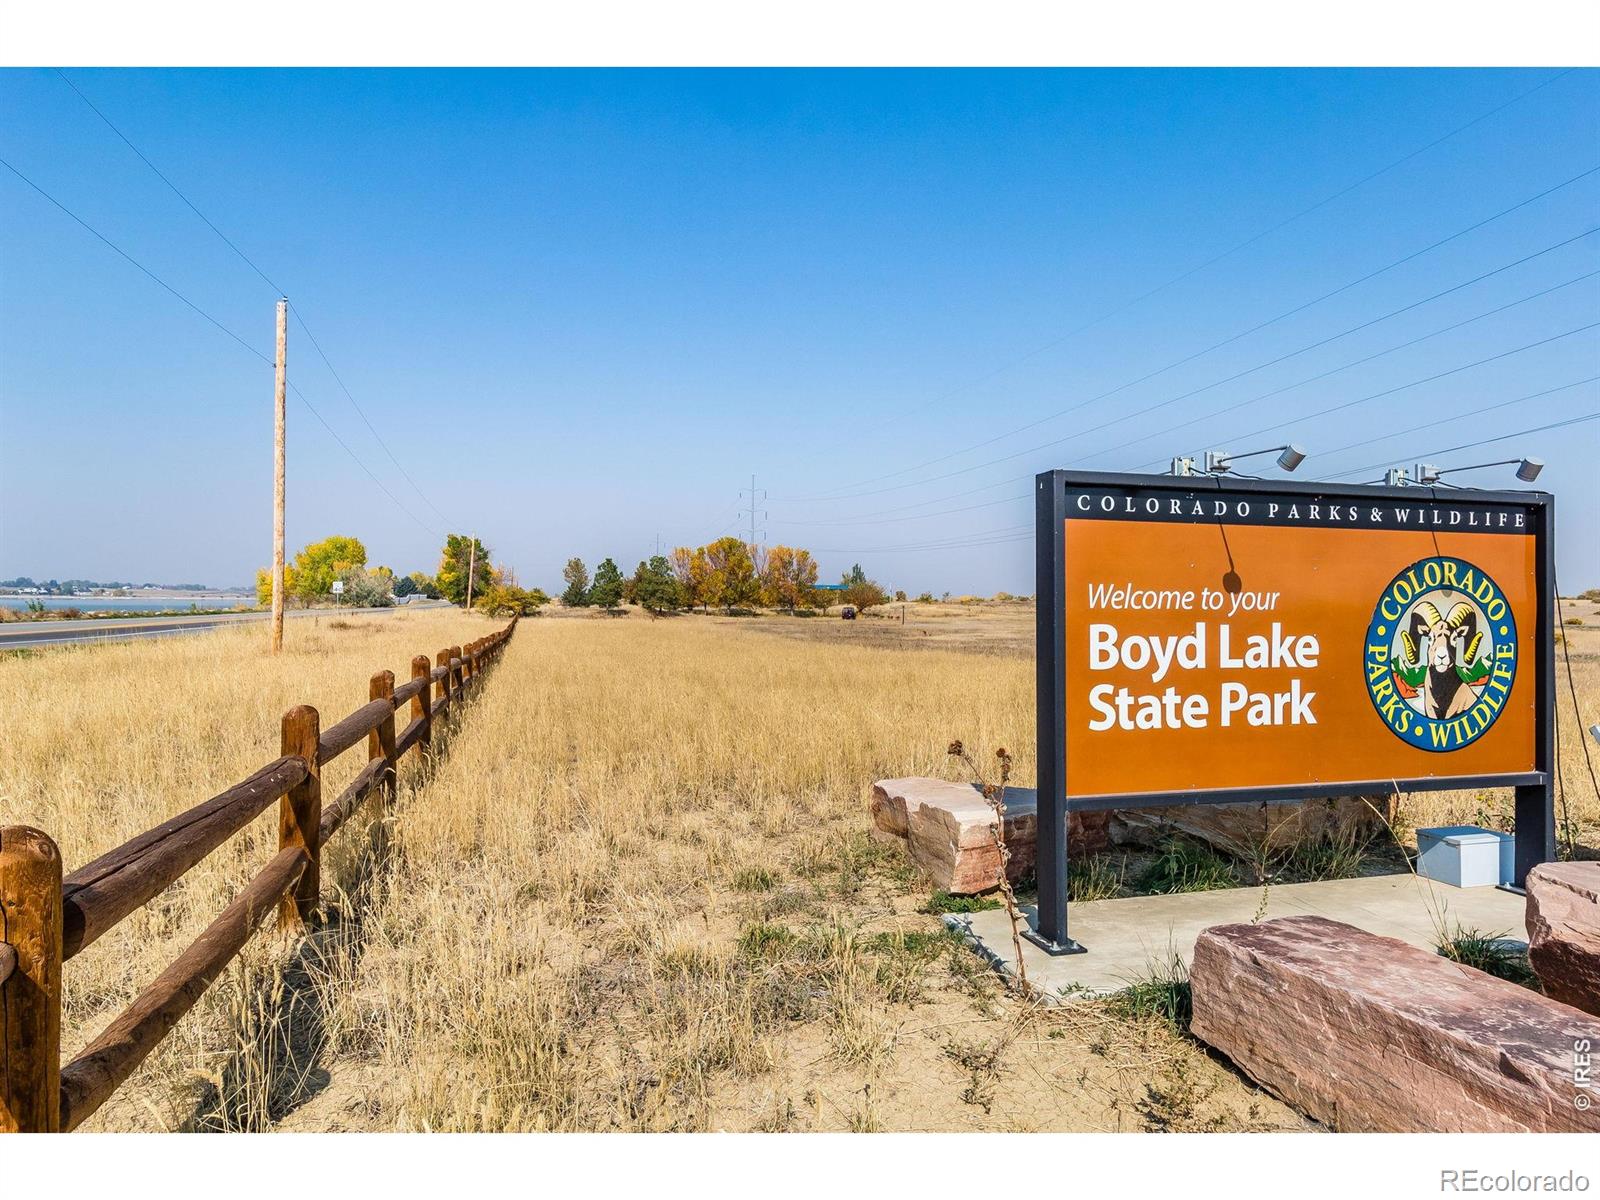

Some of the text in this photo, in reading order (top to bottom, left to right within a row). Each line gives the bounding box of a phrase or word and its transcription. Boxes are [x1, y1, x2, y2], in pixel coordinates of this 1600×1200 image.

[1077, 494, 1526, 527] COLORADO PARKS & WILDLIFE
[1088, 583, 1280, 617] Welcome to your
[1381, 561, 1506, 622] COLORADO
[1089, 622, 1320, 683] Boyd Lake
[1088, 679, 1318, 731] State Park
[1368, 643, 1414, 733] PARKS
[1429, 642, 1515, 748] WILDLIFE
